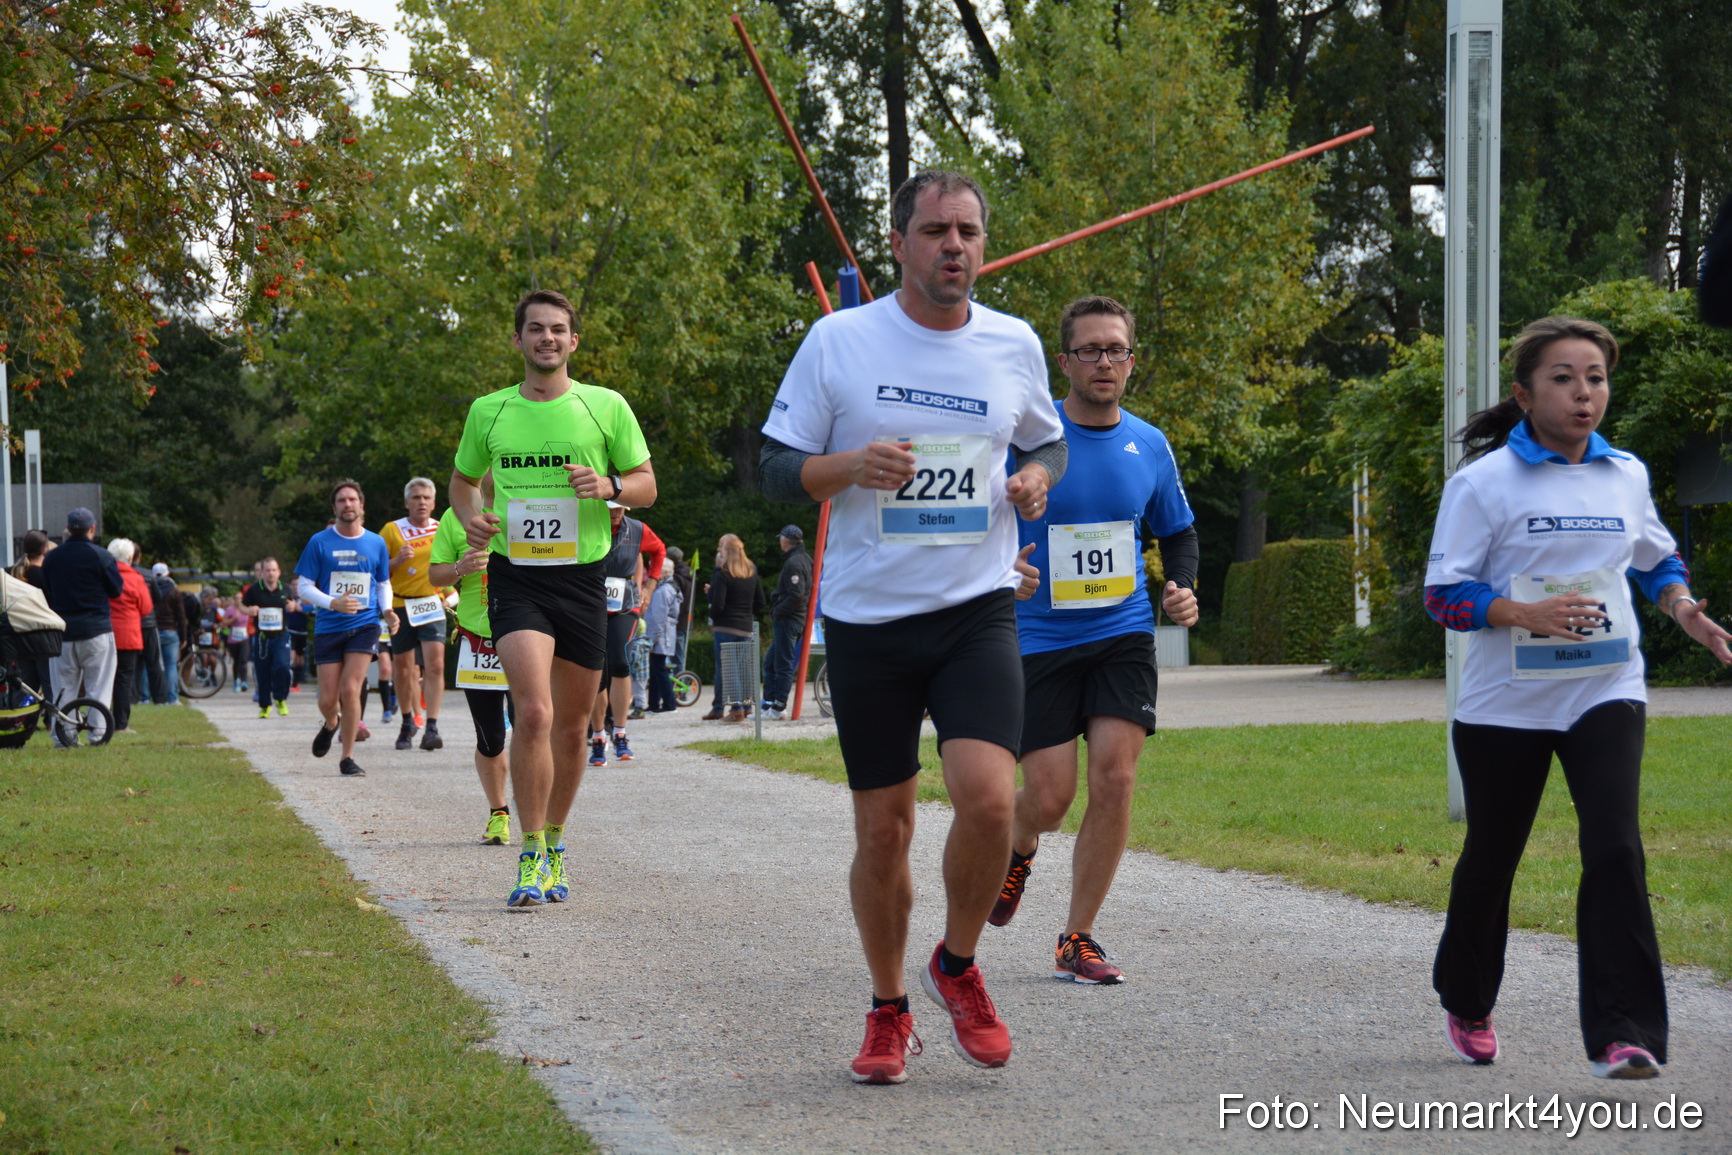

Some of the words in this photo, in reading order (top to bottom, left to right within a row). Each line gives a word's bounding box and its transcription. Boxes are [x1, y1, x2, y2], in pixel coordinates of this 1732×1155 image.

[911, 391, 984, 413] BÜSCHEL
[922, 444, 961, 453] BOCK
[895, 467, 976, 501] 2224
[918, 512, 955, 526] Stefan
[1560, 518, 1623, 530] BÜSCHEL
[523, 518, 561, 539] 212
[1083, 530, 1111, 539] BOCK
[531, 546, 554, 554] Daniel
[1071, 547, 1114, 575] 191
[335, 582, 364, 595] 2150
[606, 586, 619, 599] 00
[1084, 583, 1107, 595] Björn
[411, 601, 437, 615] 2628
[261, 614, 279, 622] 2251
[472, 653, 501, 670] 132
[1554, 649, 1592, 661] Maika
[473, 673, 497, 681] Andreas
